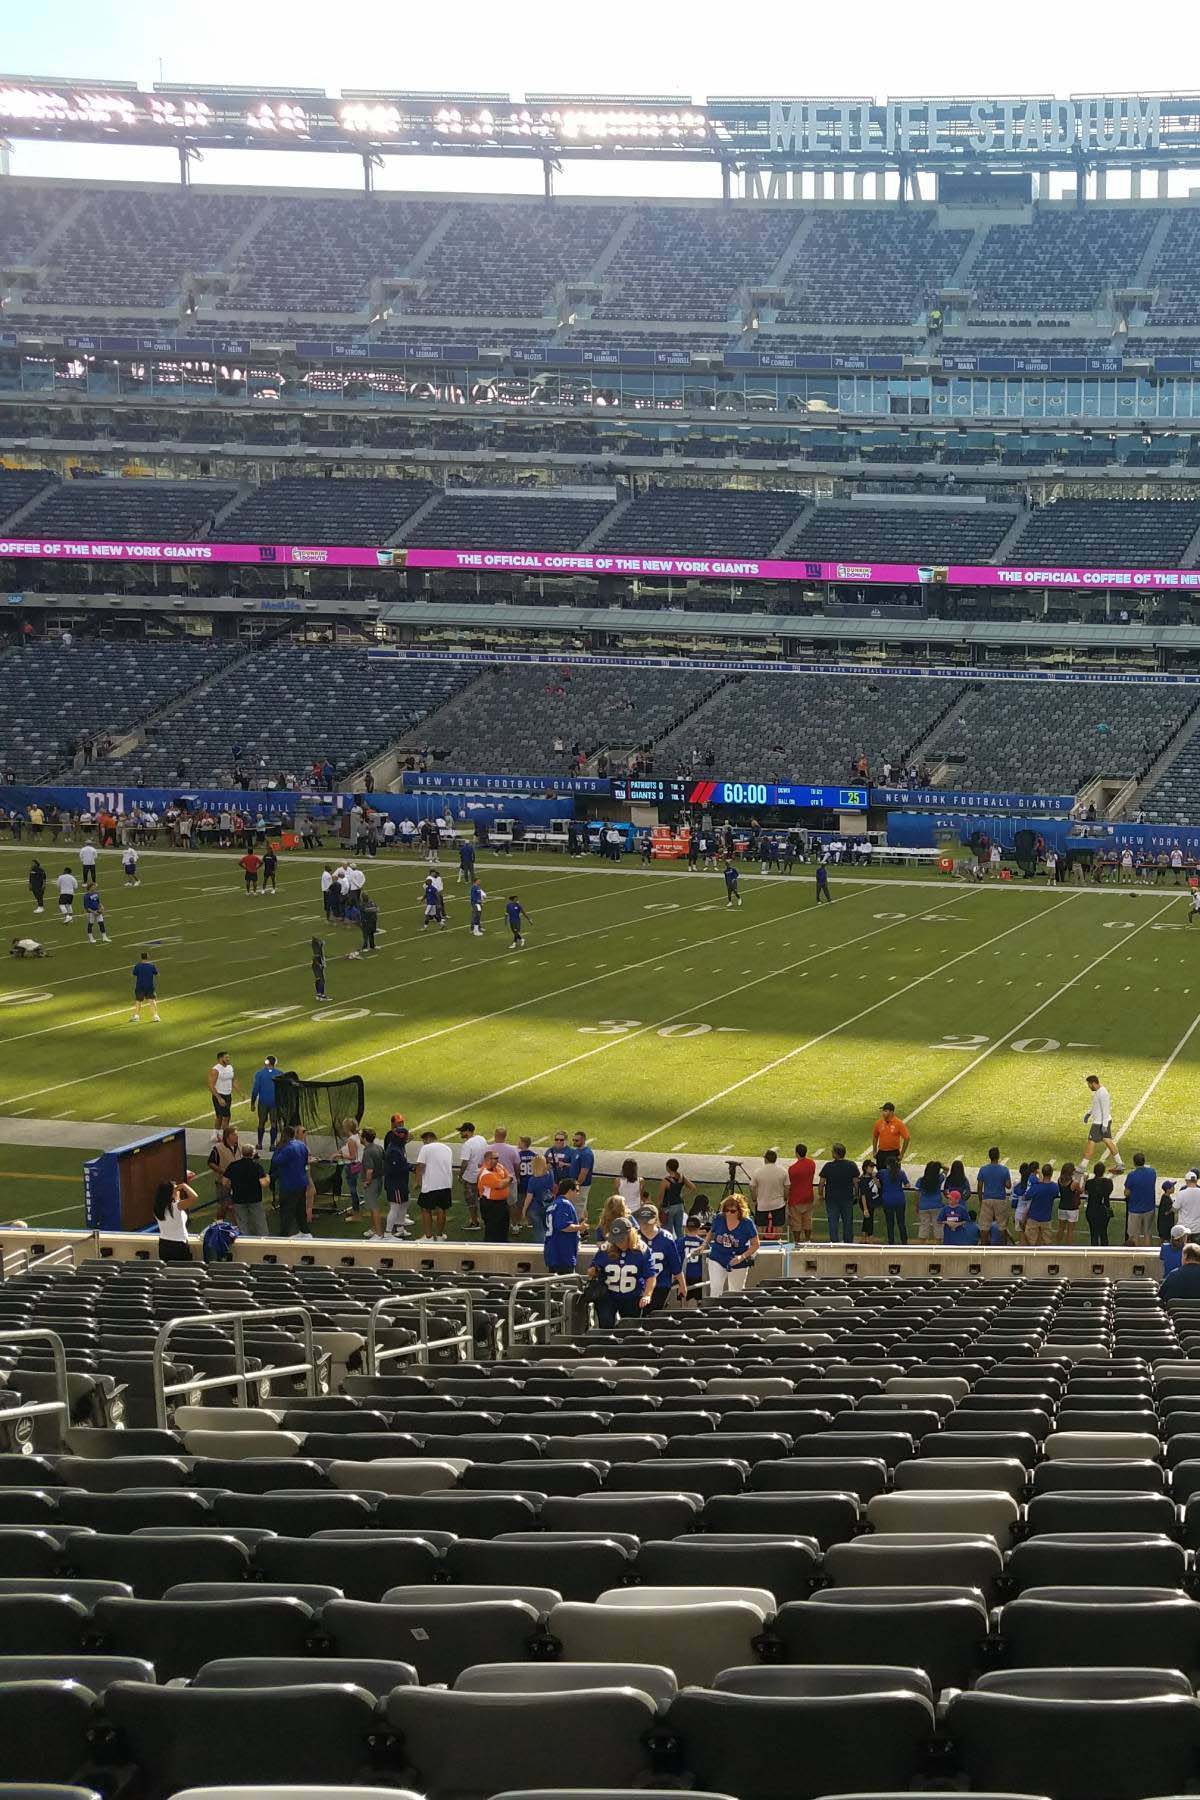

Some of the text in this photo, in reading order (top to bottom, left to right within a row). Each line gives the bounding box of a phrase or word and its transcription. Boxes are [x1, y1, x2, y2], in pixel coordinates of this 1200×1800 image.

[770, 97, 1161, 153] METLIFE STADIUM
[43, 544, 61, 553] OF
[63, 545, 89, 554] THE
[92, 546, 123, 555] NEW
[126, 546, 161, 556] YORK
[164, 547, 211, 557] GIANTS
[457, 555, 759, 574] THE OFFICIAL COFFEE OF THE NEW YORK GIANTS
[998, 571, 1022, 581] THE
[1024, 572, 1081, 582] OFFICIAL
[1083, 573, 1131, 583] COFFEE
[1134, 574, 1151, 584] OF
[1153, 574, 1178, 584] THE
[418, 777, 597, 791] NEW YORK FOOTBALL GIANTS
[658, 782, 664, 790] 0
[631, 791, 664, 800] GIANTS 0
[723, 784, 767, 804] 60:00
[847, 791, 860, 804] 25
[131, 800, 155, 809] NEW
[203, 802, 251, 812] OOTBALL
[886, 794, 1060, 809] NEW YORK FOOTBALL GIANTS
[1120, 836, 1144, 846] NEW
[1152, 837, 1179, 847] YORK
[240, 1005, 371, 1022] 40
[577, 1019, 713, 1038] 30
[929, 1034, 1061, 1054] 20
[604, 1264, 638, 1294] 26
